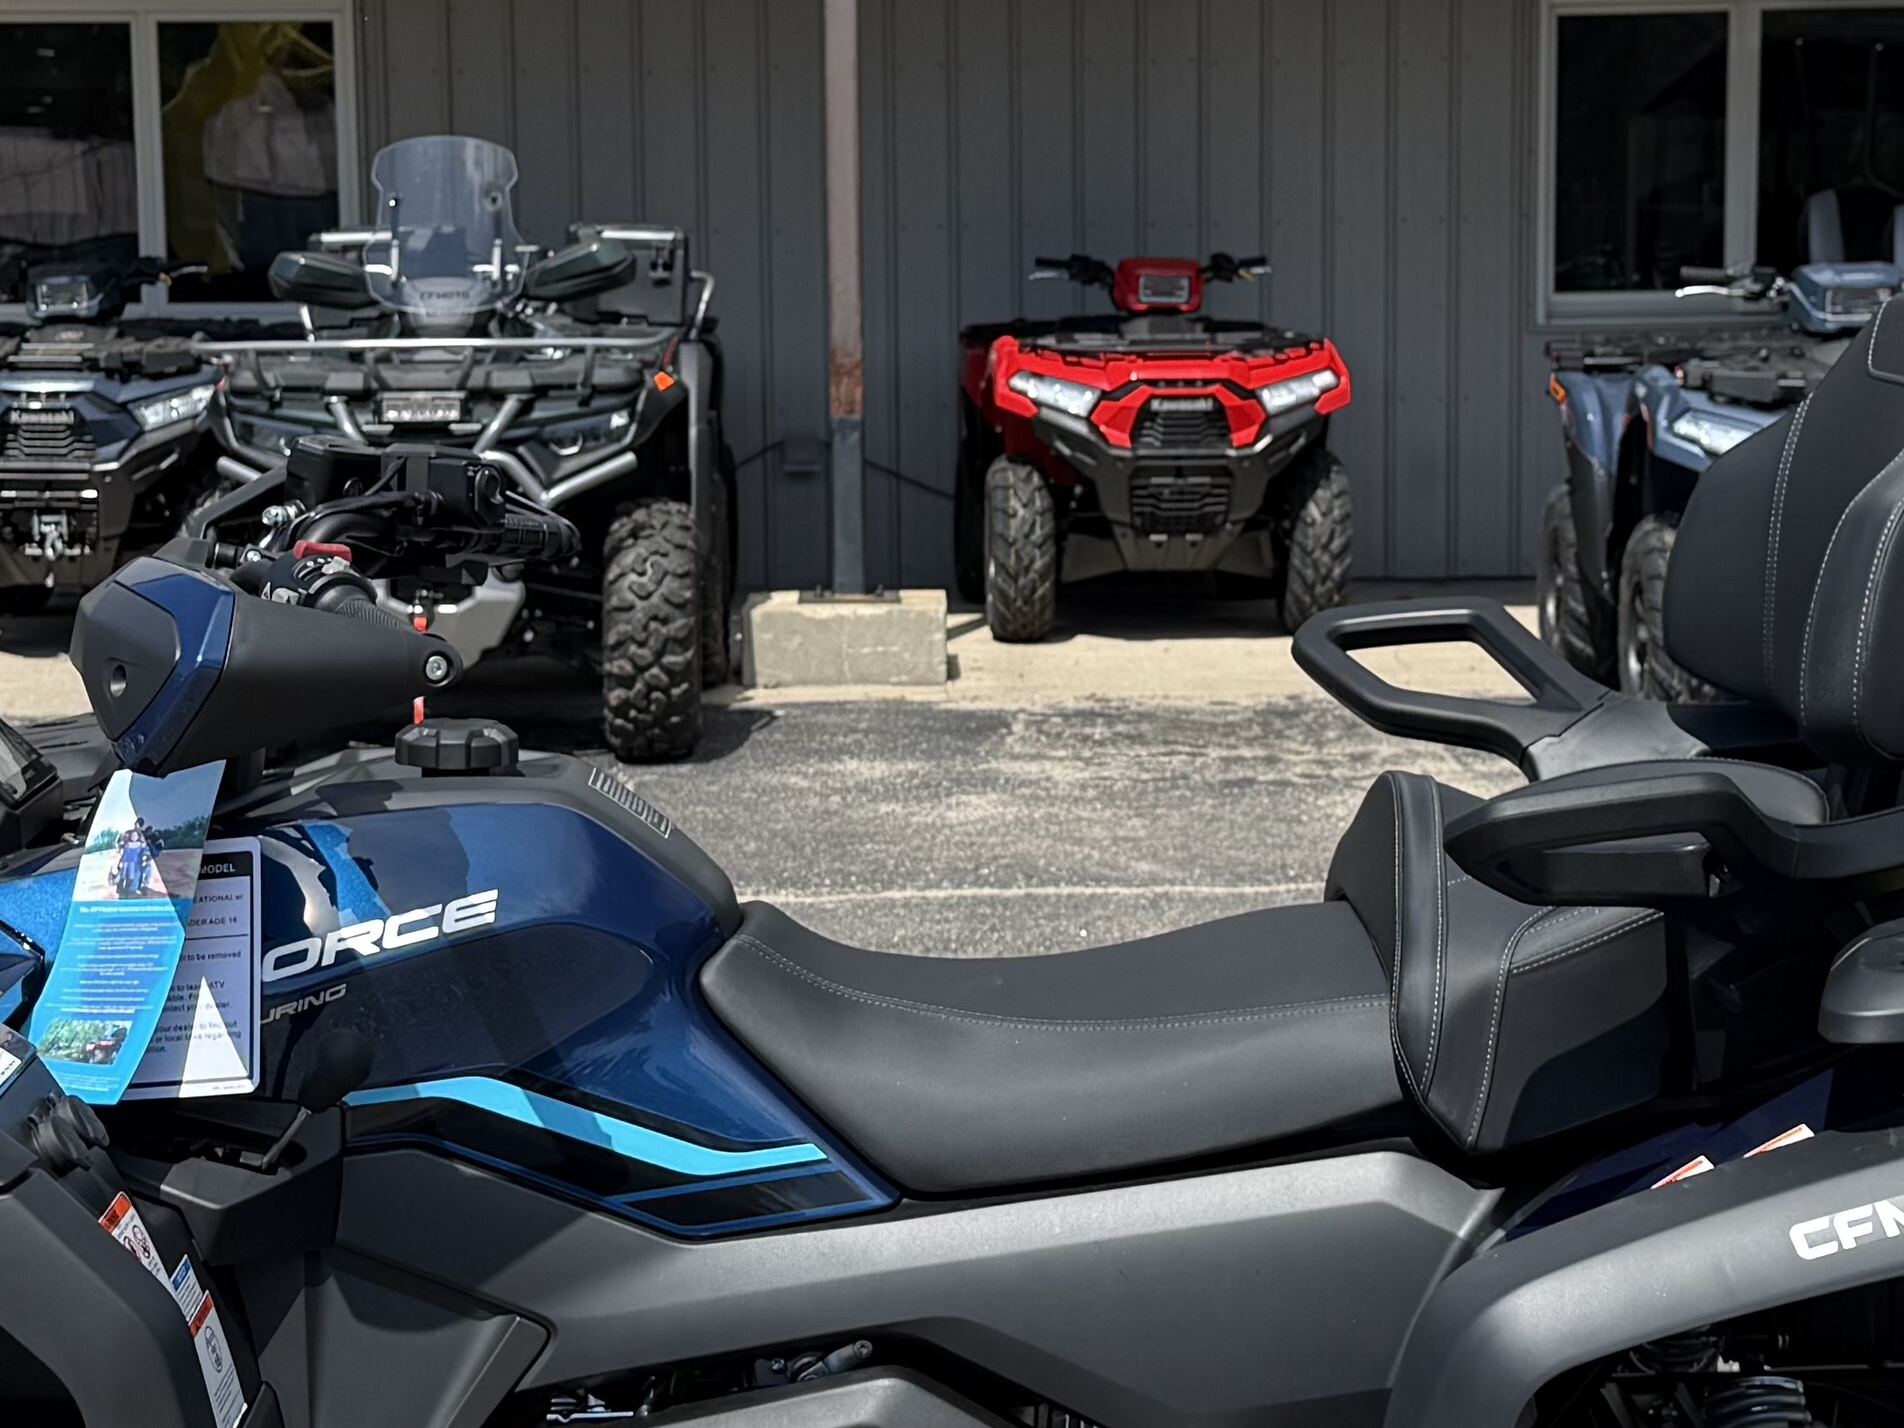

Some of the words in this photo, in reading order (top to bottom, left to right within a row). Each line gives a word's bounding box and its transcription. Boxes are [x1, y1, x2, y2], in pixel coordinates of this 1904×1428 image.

[1150, 397, 1213, 412] Kawasaki
[9, 410, 75, 424] Kawasaki
[262, 889, 499, 983] ORCE
[208, 950, 242, 960] removed
